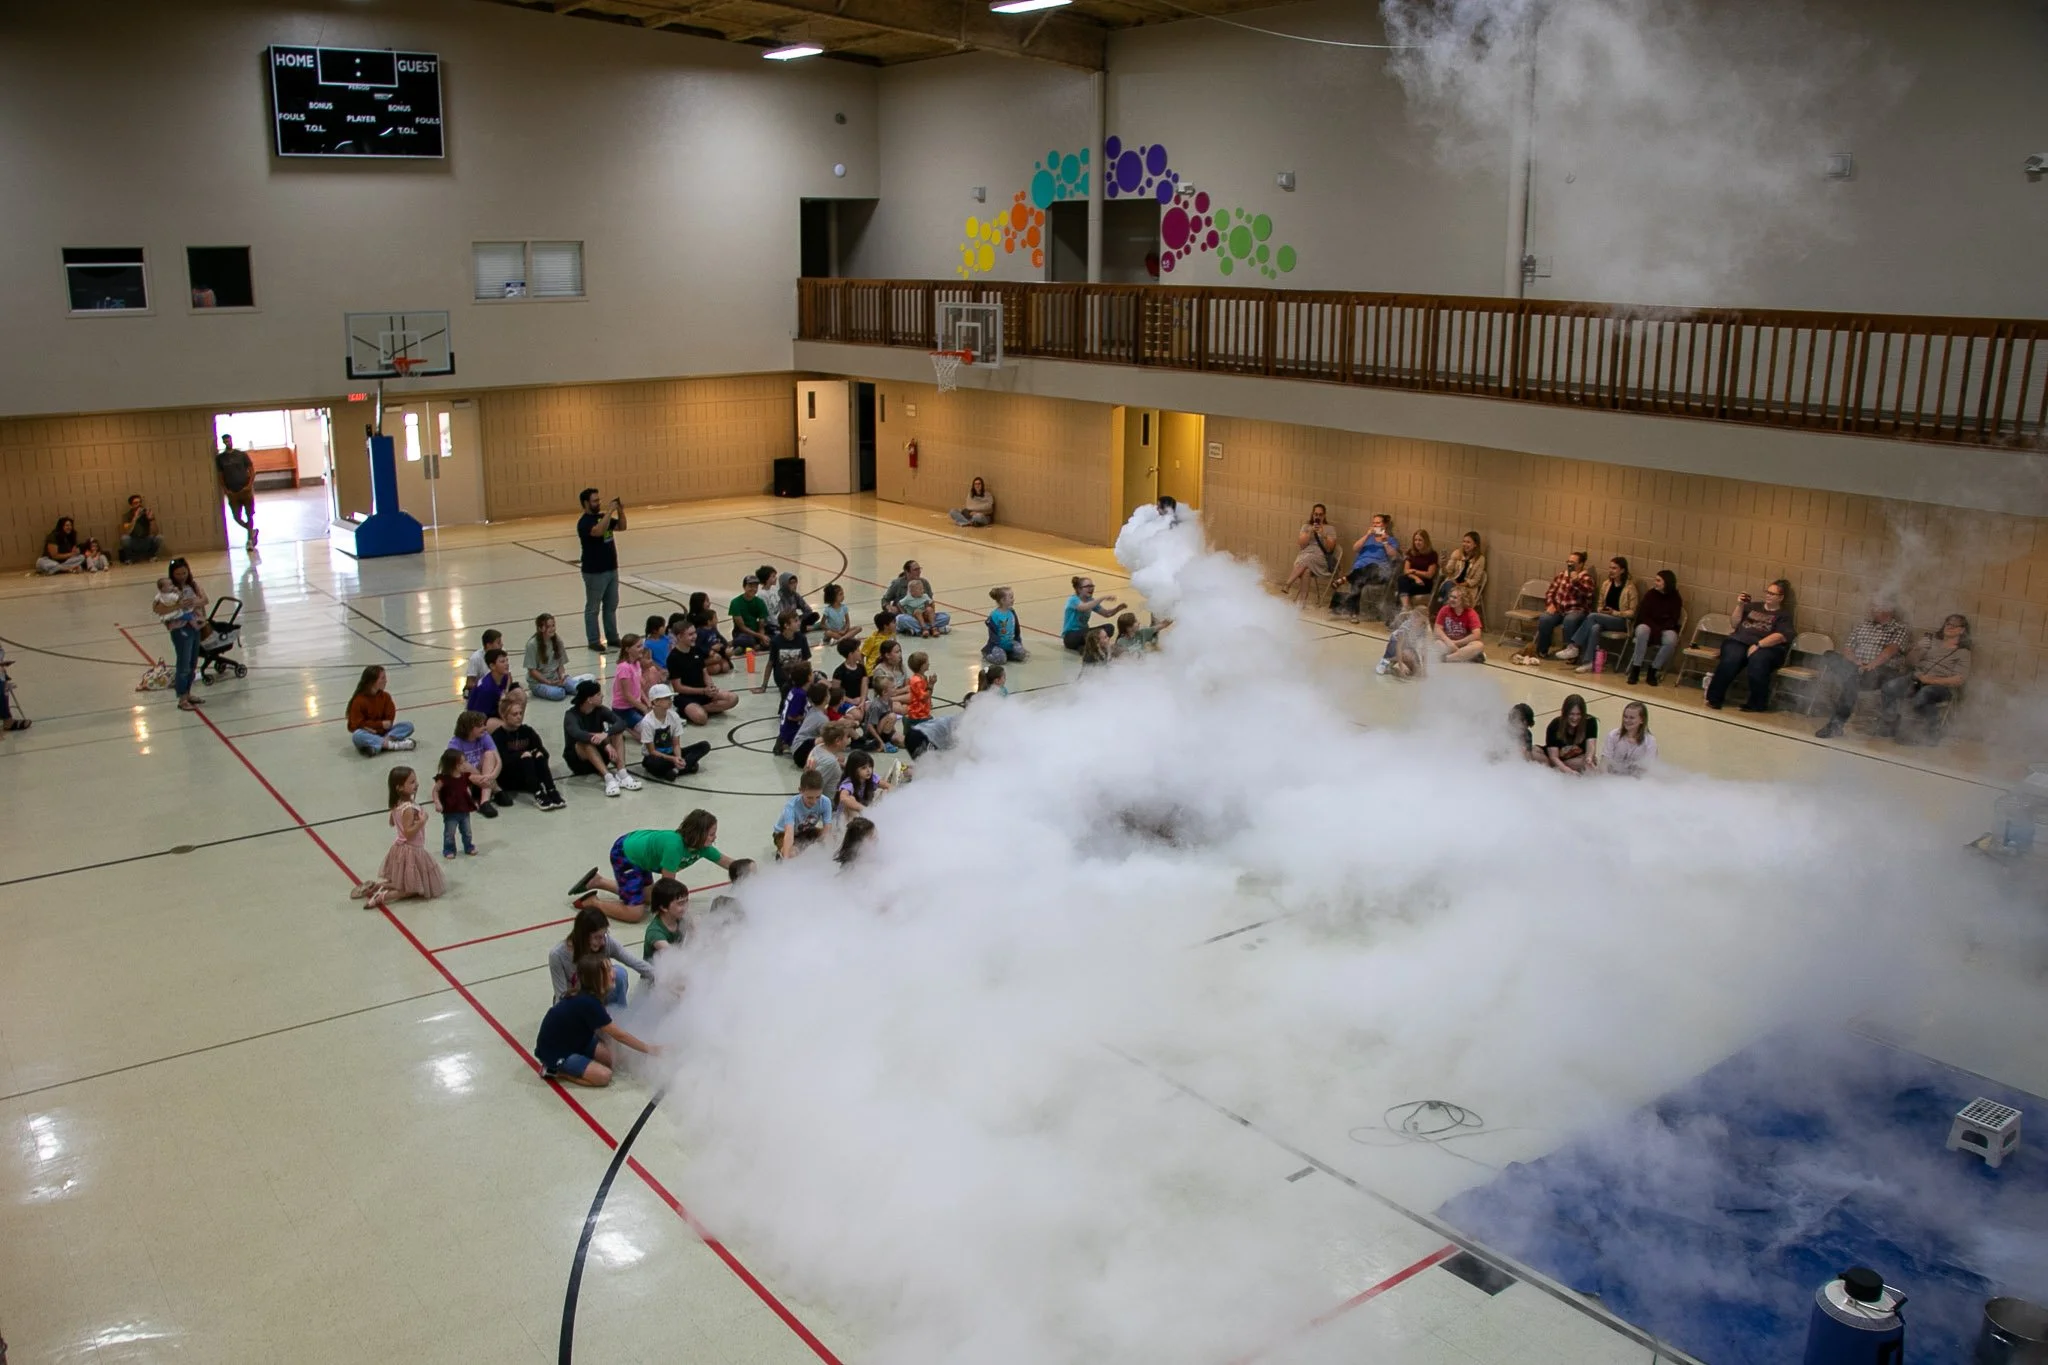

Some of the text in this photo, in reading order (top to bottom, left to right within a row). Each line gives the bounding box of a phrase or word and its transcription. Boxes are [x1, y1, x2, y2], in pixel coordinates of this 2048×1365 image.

[276, 53, 314, 68] HOME
[398, 60, 437, 73] GUEST
[309, 102, 333, 110] BONUS
[388, 104, 411, 112] BONUS
[279, 113, 305, 121] FOULS
[346, 115, 376, 123] PLAYER
[415, 117, 440, 125] FOULS
